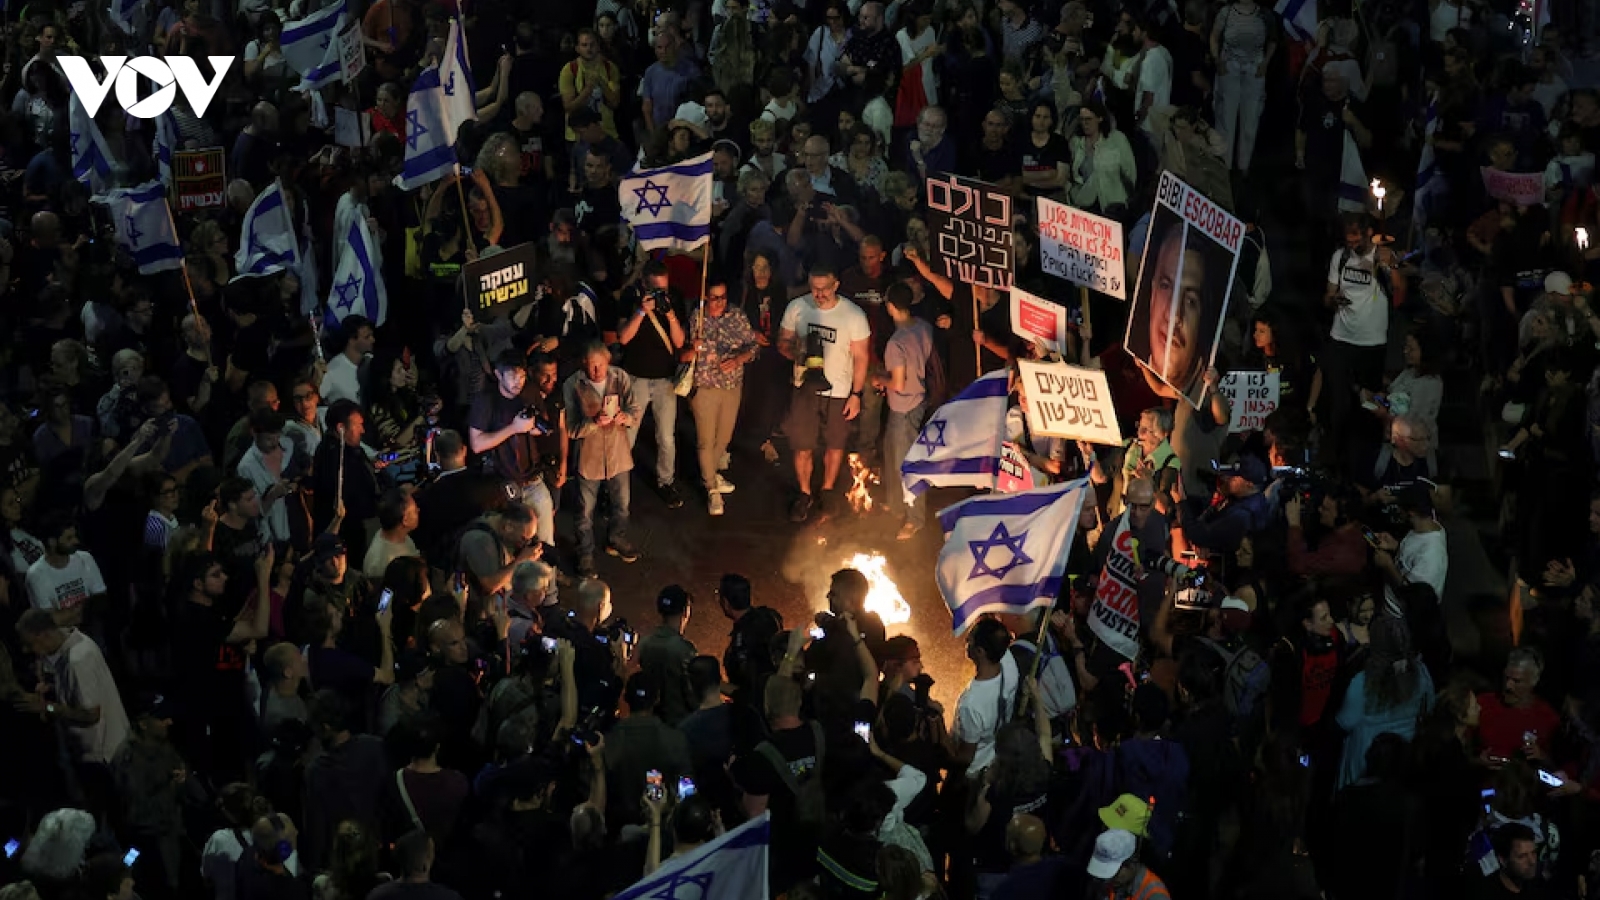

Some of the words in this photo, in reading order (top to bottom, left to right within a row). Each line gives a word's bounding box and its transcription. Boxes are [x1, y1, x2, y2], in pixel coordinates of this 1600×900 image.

[926, 176, 1010, 227] כולם
[1160, 174, 1186, 211] BIBI
[1184, 190, 1241, 251] ESCOBAR
[939, 232, 1008, 269] כולם
[479, 262, 524, 292] עסקה
[942, 256, 1013, 292] עכשיו
[479, 278, 529, 309] עכשיו!
[1034, 371, 1099, 402] פושעים
[1036, 396, 1108, 431] בשלטון
